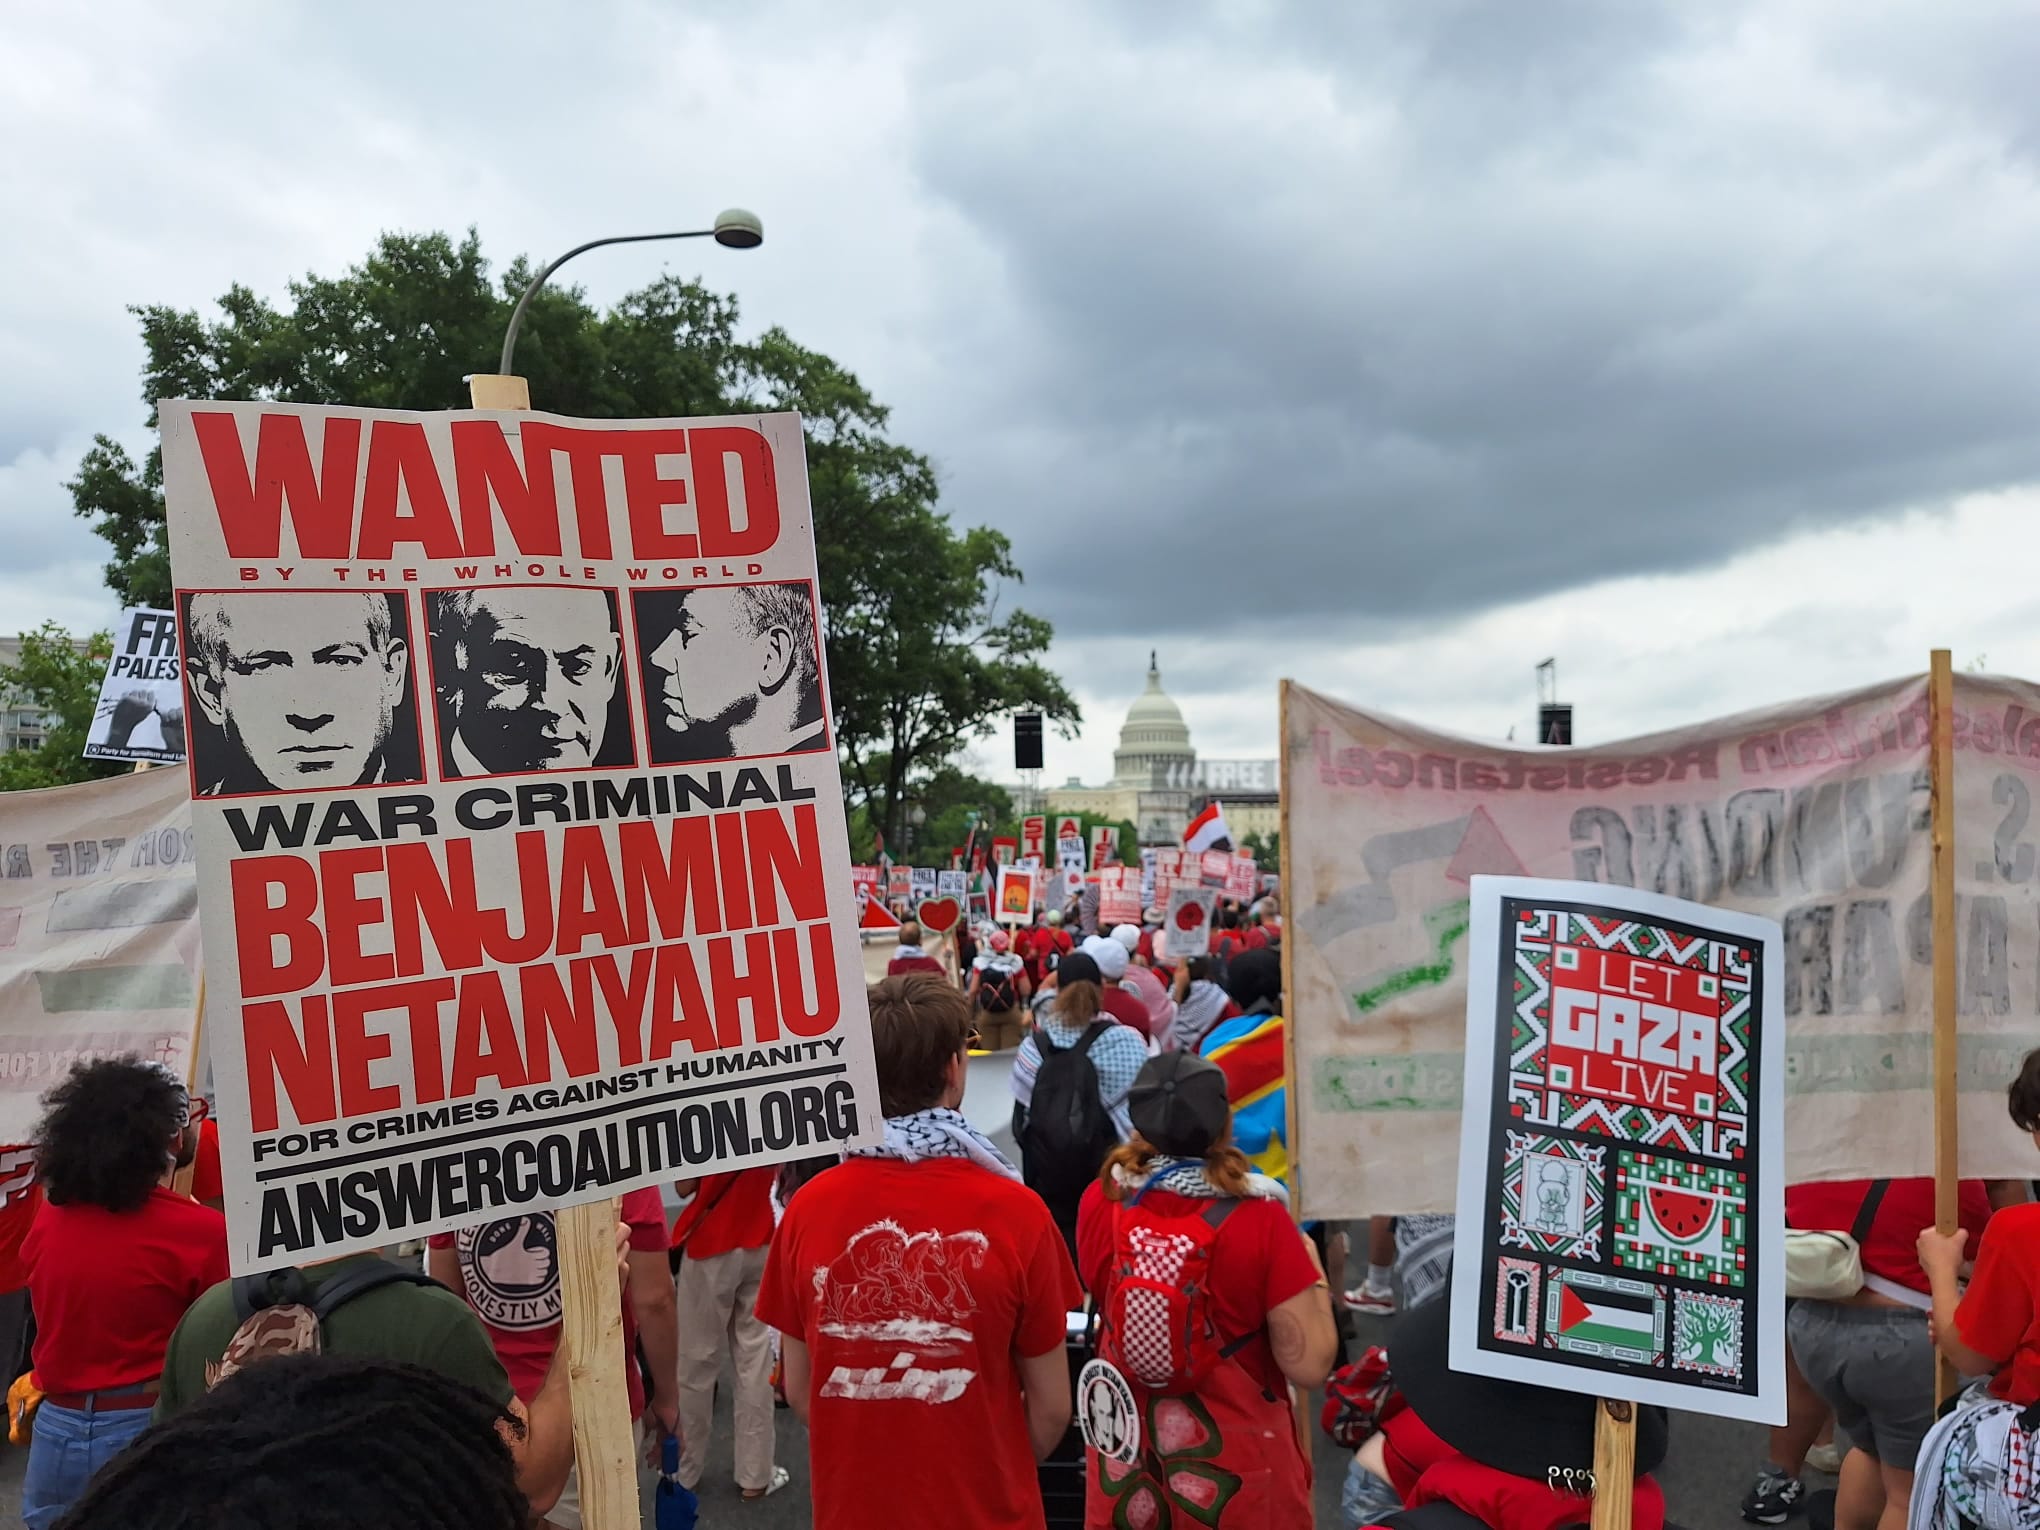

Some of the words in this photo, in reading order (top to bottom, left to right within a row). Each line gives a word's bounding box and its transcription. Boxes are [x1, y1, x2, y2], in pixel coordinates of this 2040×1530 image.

[191, 411, 780, 560] WANTED
[240, 567, 294, 582] BY
[334, 567, 417, 582] THE
[454, 564, 597, 579] WHOLE
[626, 563, 763, 581] WORLD
[222, 799, 437, 852] WAR
[454, 764, 816, 832] CRIMINAL
[1207, 763, 1265, 791] FREE
[230, 803, 829, 998] BENJAMIN
[1599, 955, 1681, 1003] LET
[241, 922, 841, 1133] NETANYAHU
[1551, 988, 1719, 1075] GAZA
[252, 1131, 341, 1162] FOR
[347, 1098, 499, 1145] CRIMES
[506, 1067, 661, 1116] AGAINST
[665, 1037, 845, 1083] HUMANITY
[1581, 1060, 1689, 1111] LIVE
[258, 1080, 859, 1257] ANSWERCOALITION.ORG
[489, 1222, 511, 1243] DONE
[536, 1222, 552, 1242] WELL
[464, 1269, 538, 1320] HONESTLY
